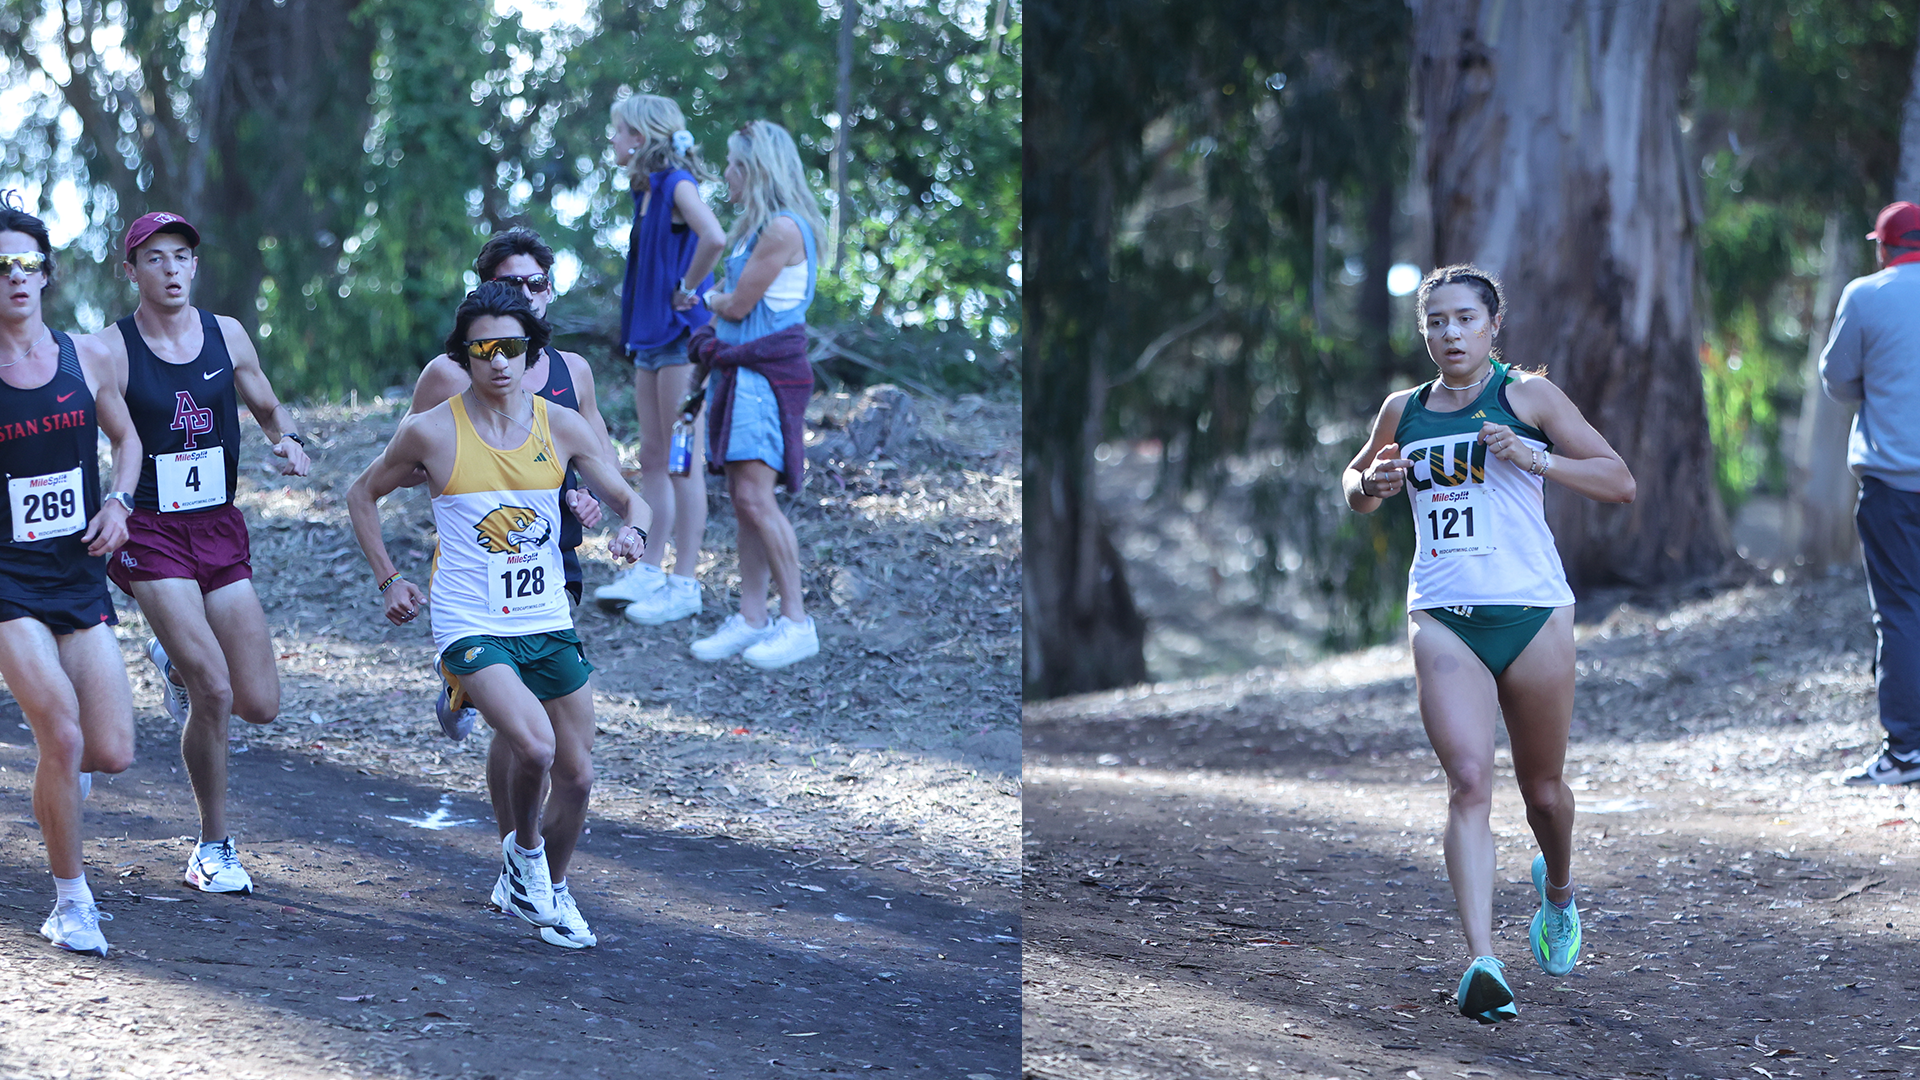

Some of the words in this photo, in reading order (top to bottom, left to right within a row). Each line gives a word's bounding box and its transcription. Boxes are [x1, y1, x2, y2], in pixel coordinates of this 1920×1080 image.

[42, 409, 85, 432] STATE
[170, 390, 213, 450] AP
[174, 450, 208, 462] MileSplit
[1406, 441, 1487, 492] CUI
[185, 466, 201, 492] 4
[23, 488, 76, 524] 269
[1431, 491, 1469, 503] MileSplit
[1428, 506, 1474, 541] 121
[500, 565, 545, 599] 128
